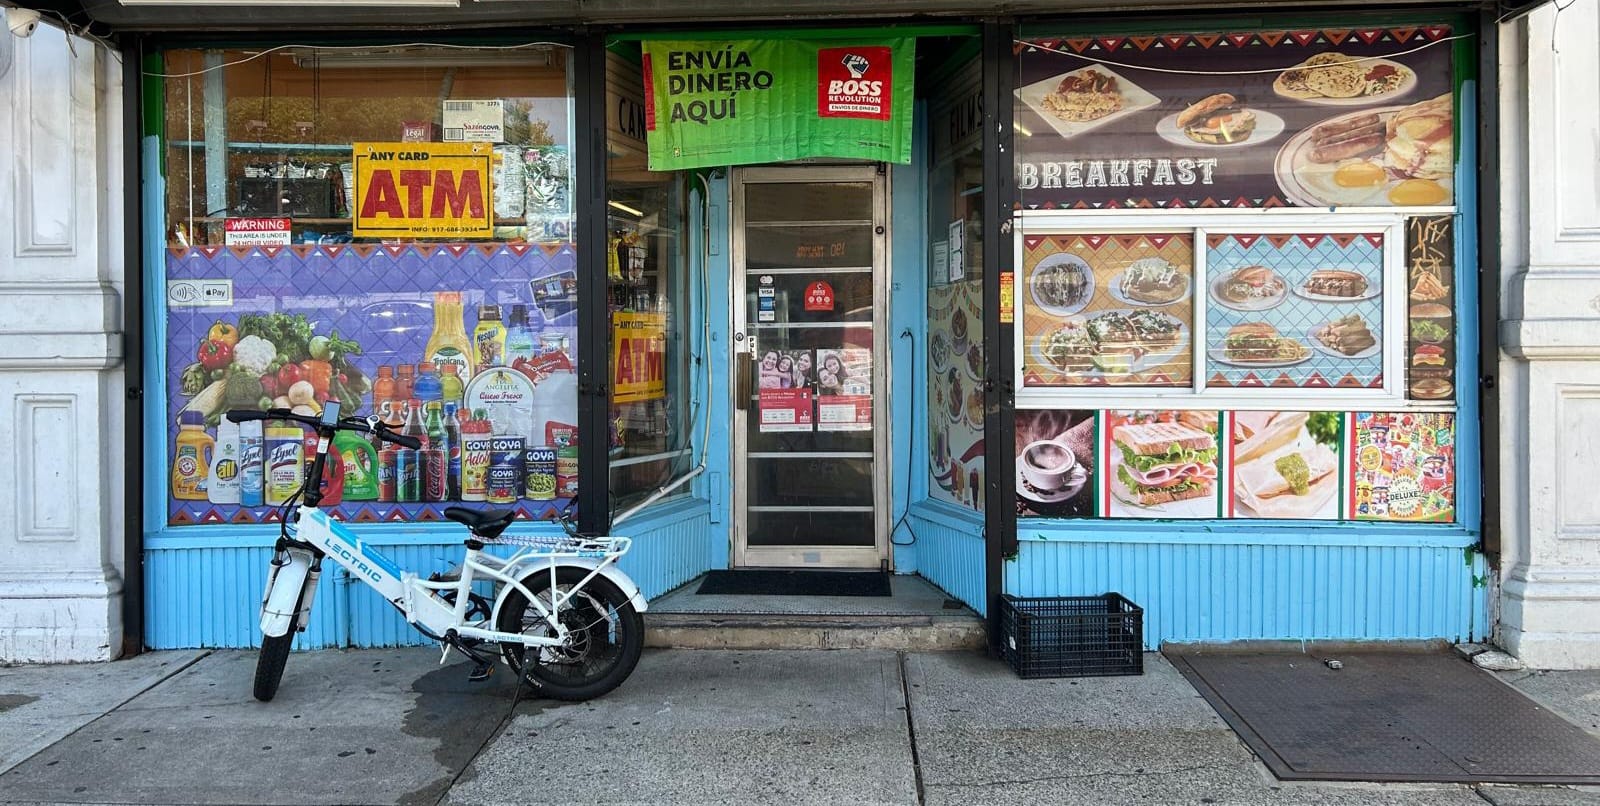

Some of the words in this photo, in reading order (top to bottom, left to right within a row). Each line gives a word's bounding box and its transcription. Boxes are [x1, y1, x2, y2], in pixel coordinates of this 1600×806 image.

[669, 45, 752, 70] ENVÍA
[669, 70, 773, 95] DINERO
[828, 80, 882, 96] BOSS
[829, 95, 881, 103] REVOLUTION
[671, 92, 735, 125] AQUÍ
[370, 152, 395, 160] ANY
[397, 152, 430, 160] CARD
[1018, 158, 1218, 189] BREAKFAST
[360, 169, 485, 219] ATM
[231, 220, 285, 230] WARNING
[212, 289, 226, 298] Pay
[433, 357, 465, 368] Tropicana
[615, 338, 664, 385] ATM
[501, 390, 523, 400] Fresco
[493, 440, 521, 450] GOYA
[241, 447, 262, 465] Lysol
[271, 445, 299, 463] Lysol
[526, 451, 555, 462] GOYA
[218, 460, 237, 479] all
[492, 470, 514, 478] GOYA
[1390, 490, 1419, 501] DELUXE
[325, 538, 382, 582] LECTRIC
